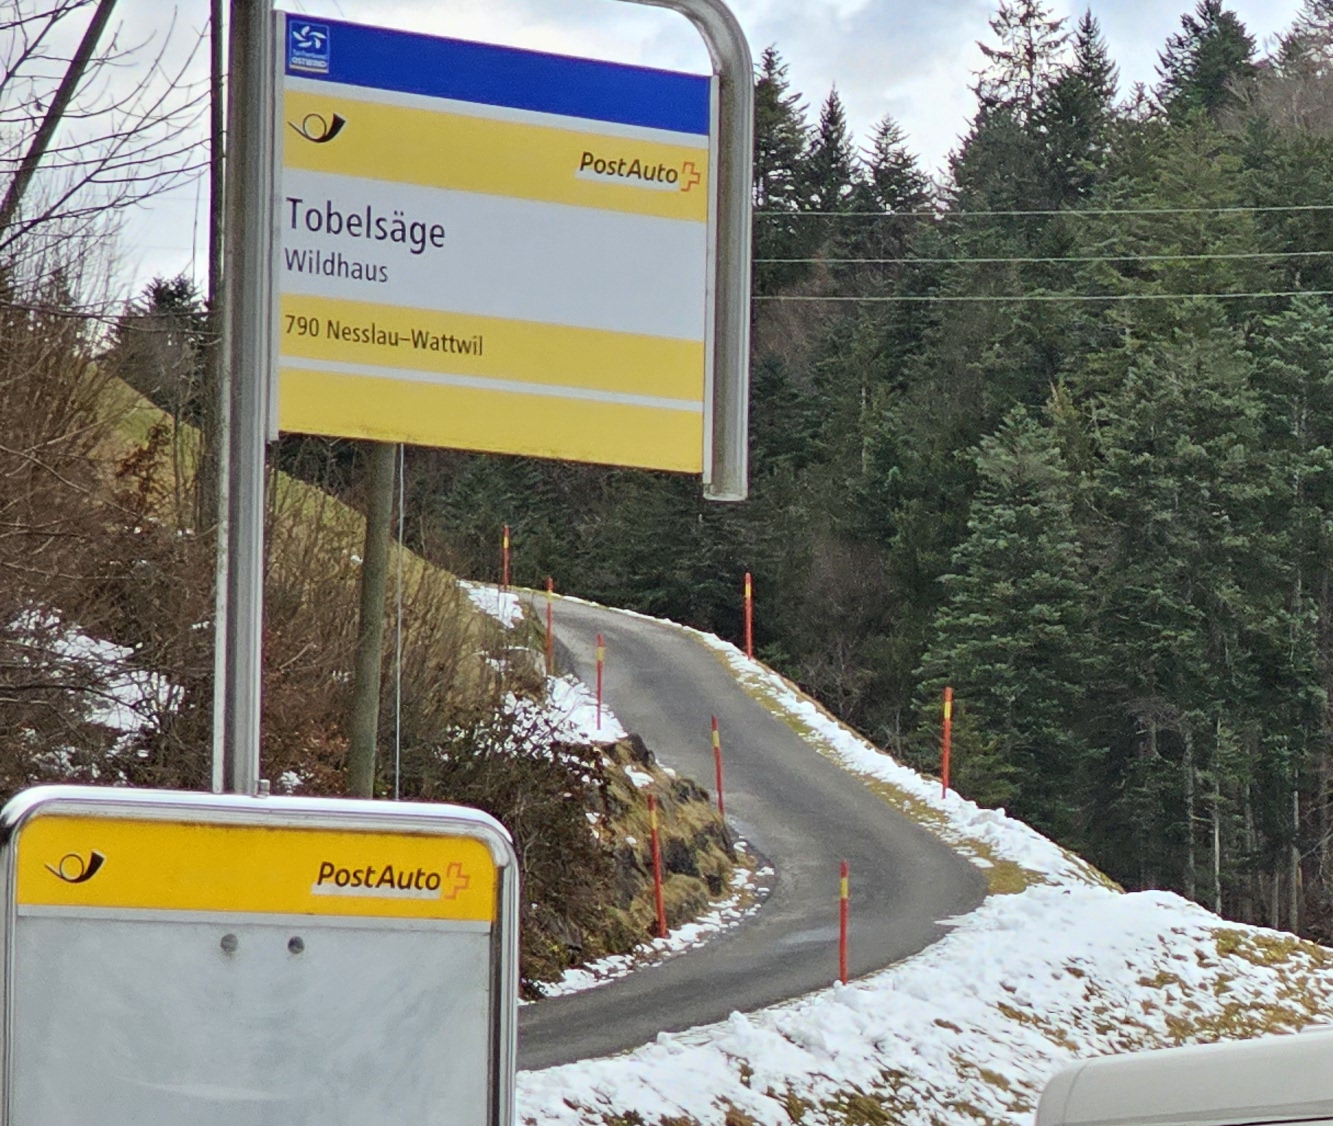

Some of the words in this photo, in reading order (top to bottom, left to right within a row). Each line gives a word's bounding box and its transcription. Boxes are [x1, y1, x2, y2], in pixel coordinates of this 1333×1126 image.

[579, 151, 679, 184] PostAuto
[286, 197, 446, 254] Tobelsäge
[284, 247, 389, 283] Wildhaus
[285, 314, 320, 338] 790
[316, 861, 442, 892] PostAuto
